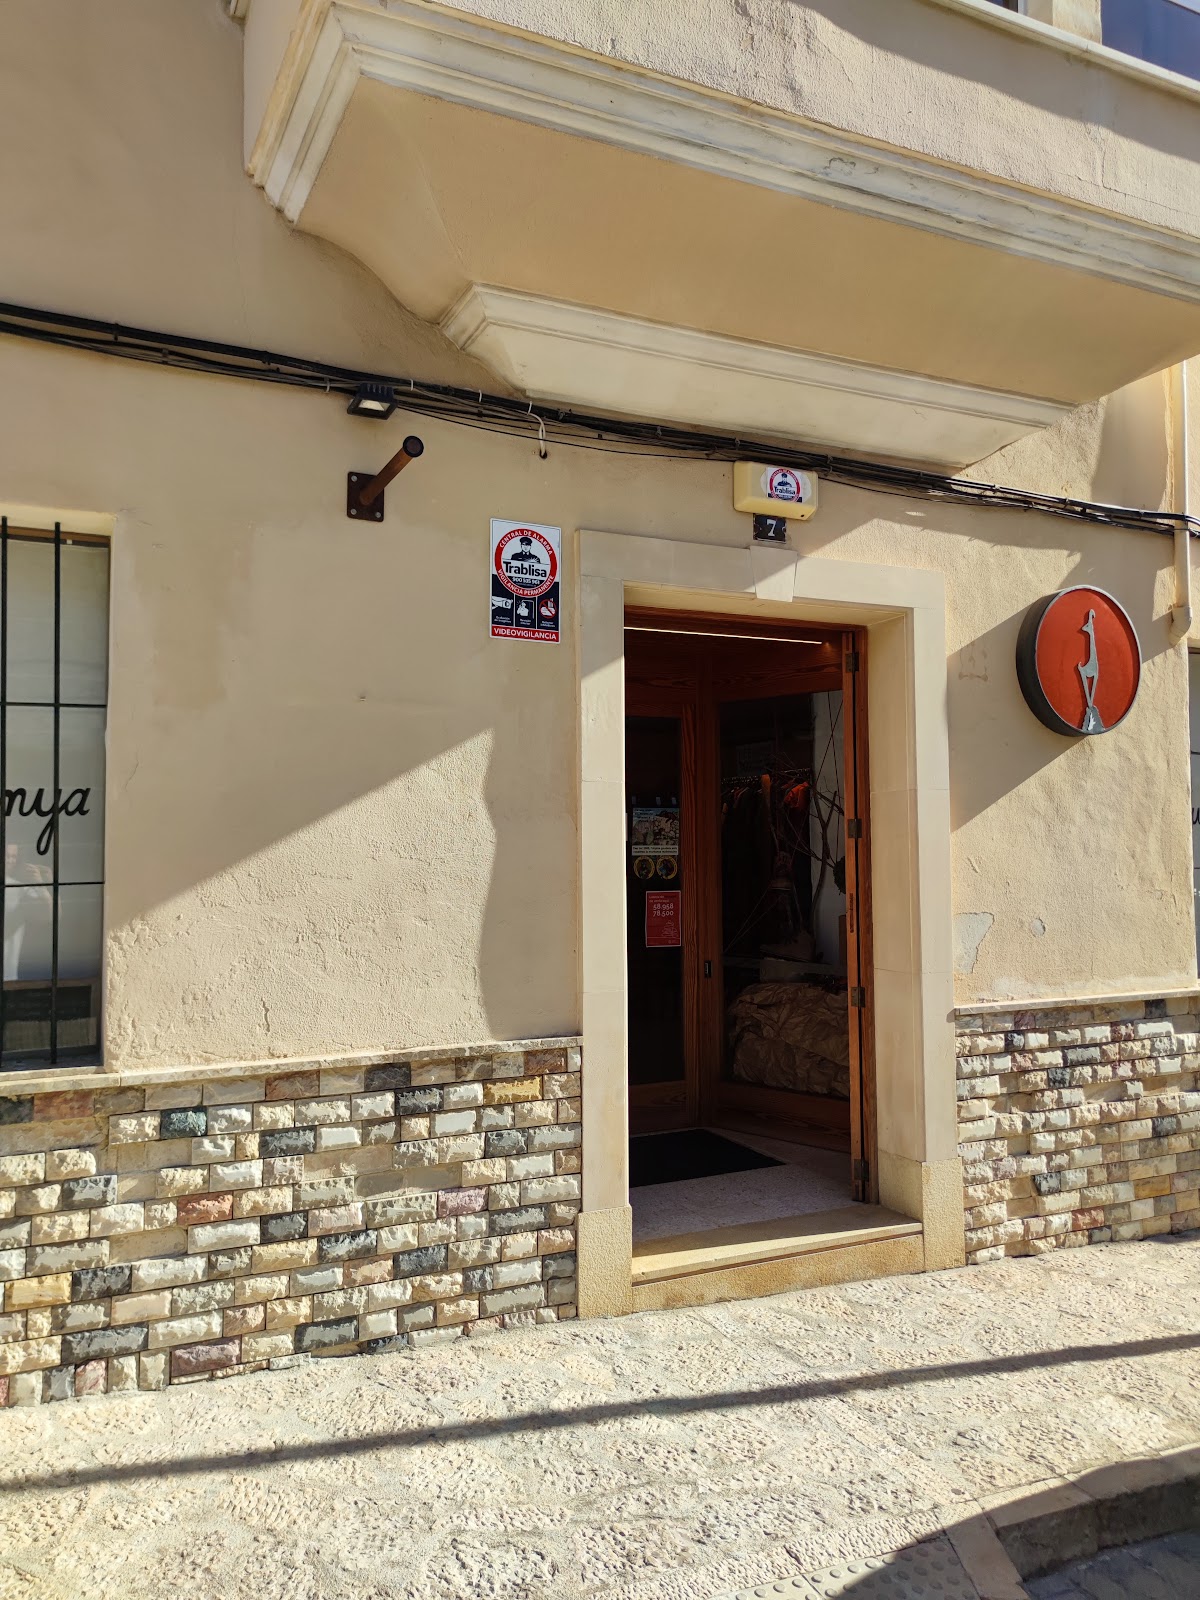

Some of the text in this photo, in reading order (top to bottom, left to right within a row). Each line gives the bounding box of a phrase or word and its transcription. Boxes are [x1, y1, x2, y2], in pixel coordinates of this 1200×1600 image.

[766, 518, 777, 537] 7
[500, 530, 523, 548] CENTRAL
[532, 533, 553, 555] ALARMA
[502, 560, 547, 578] Trablisa
[497, 569, 555, 596] VIGILANCIA PERMANENTE
[493, 627, 557, 640] VIDEOVIGILANCIA
